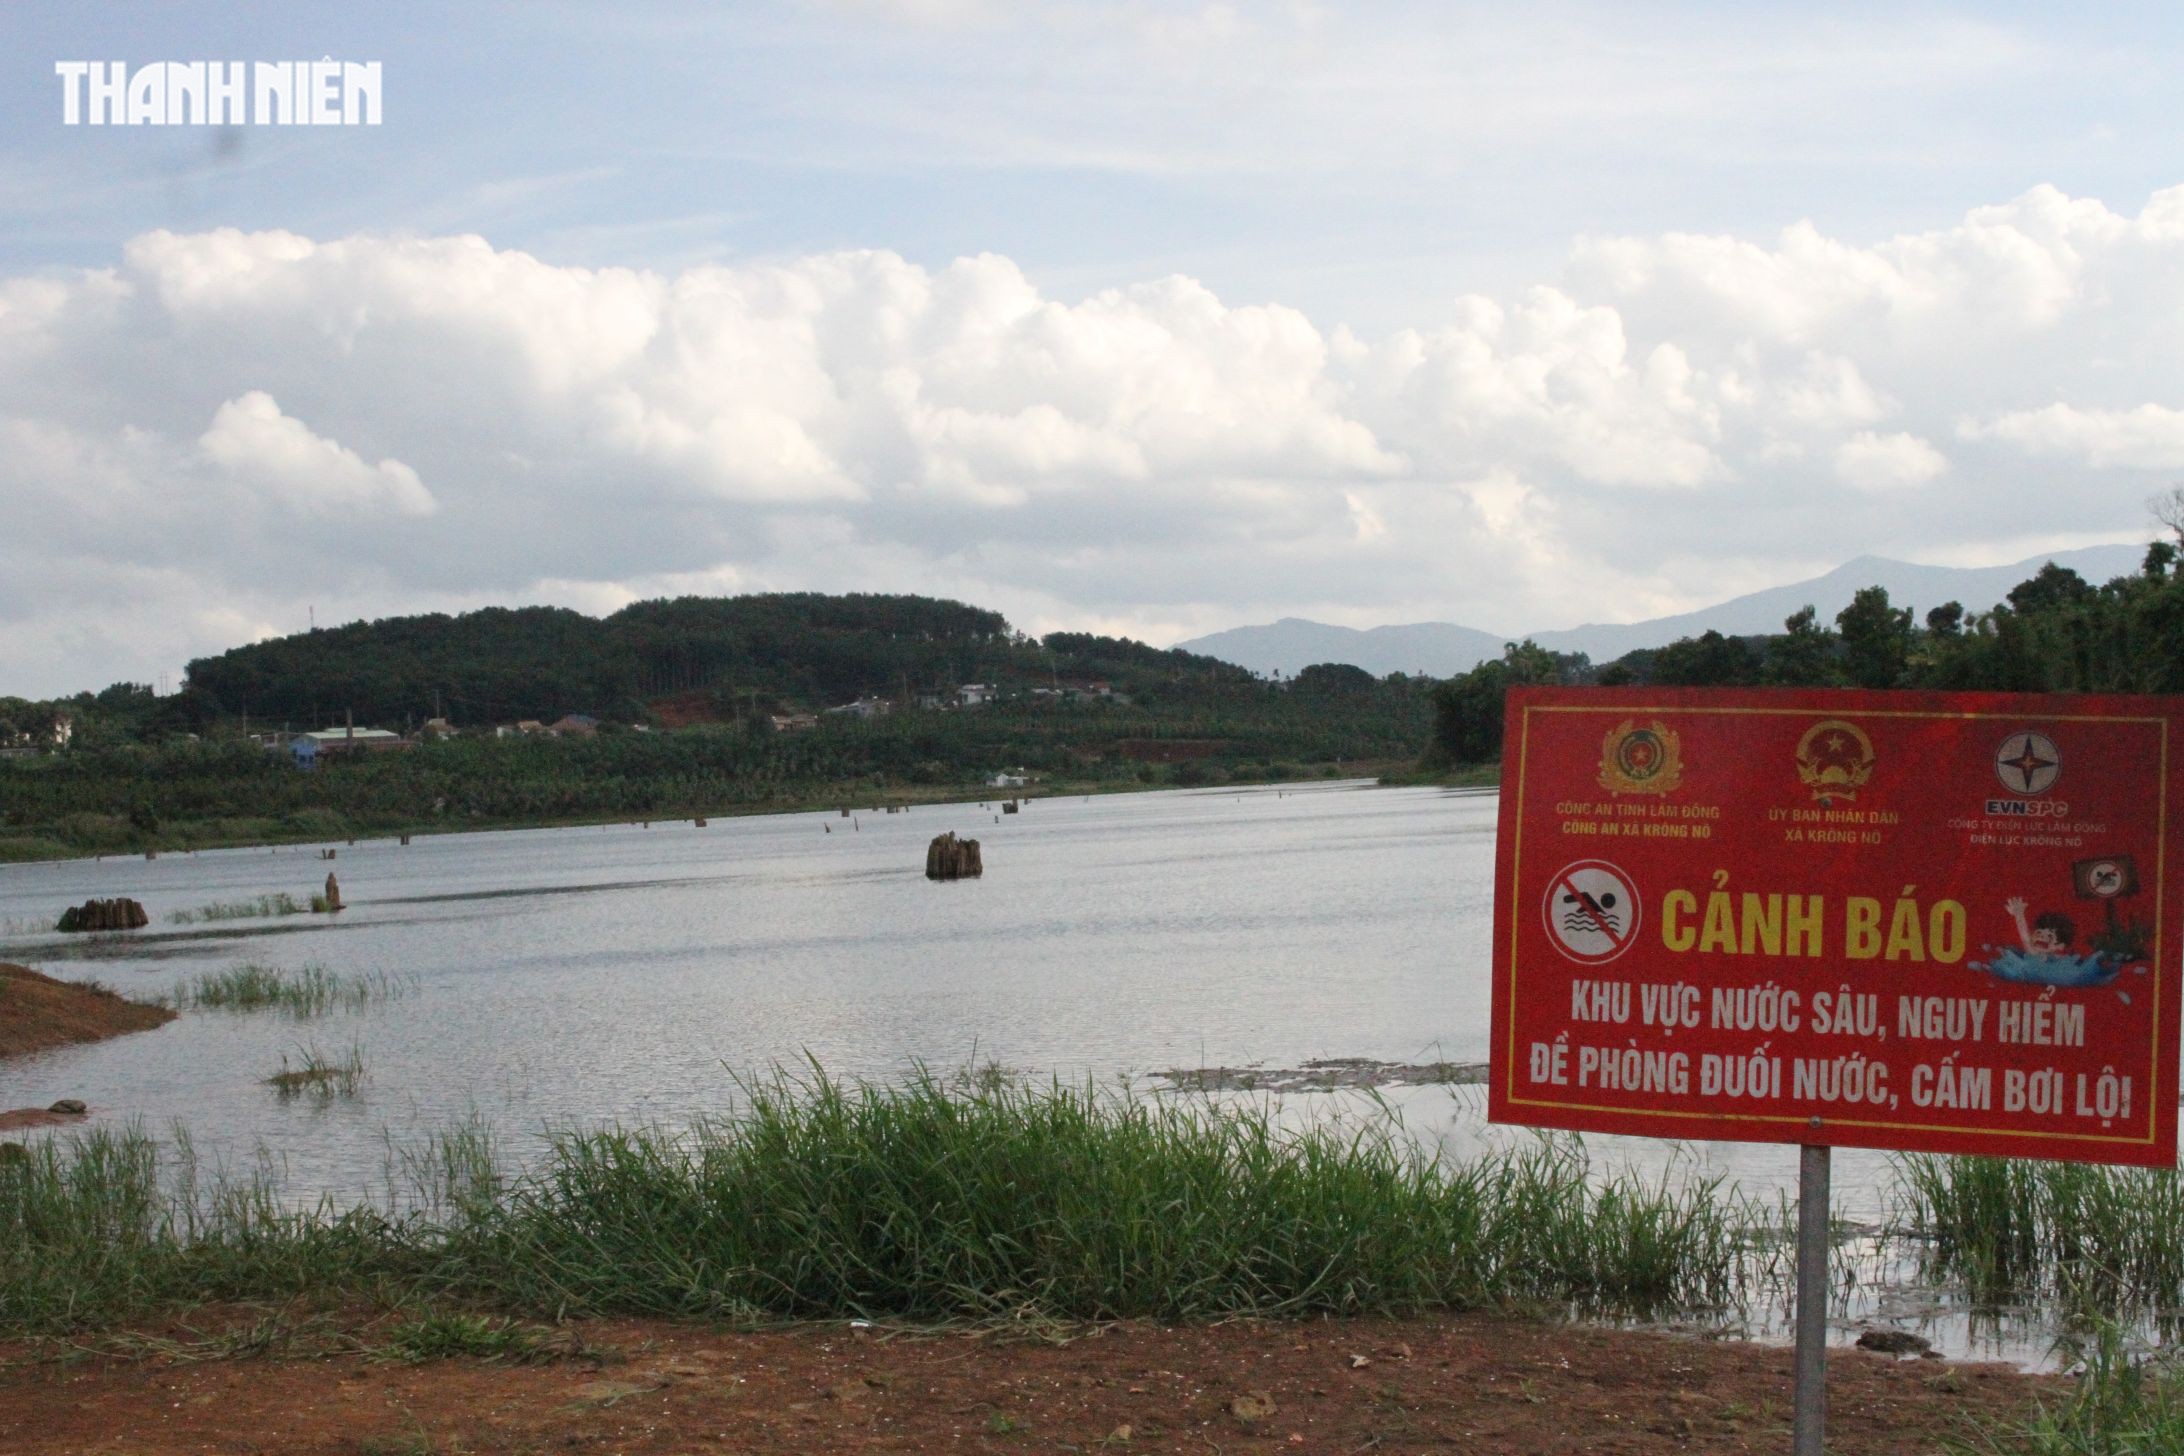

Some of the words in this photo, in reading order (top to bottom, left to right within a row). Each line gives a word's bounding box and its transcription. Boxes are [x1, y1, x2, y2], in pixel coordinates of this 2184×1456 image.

[1595, 803, 1612, 815] AN
[1601, 822, 1619, 835] AN
[1792, 808, 1820, 822] BAN
[1661, 869, 1824, 958] CẢNH
[1845, 884, 1967, 963] BÁO
[1571, 979, 1631, 1024] KHU
[1640, 980, 1701, 1036] VỰC
[1712, 980, 1801, 1033] NƯỚC
[1812, 983, 1886, 1042] SÂU,
[1898, 994, 1989, 1043] NGUY
[1998, 984, 2086, 1047] HIỂM
[1529, 1029, 1569, 1086] ĐỀ
[1578, 1038, 1690, 1096] PHÒNG
[1700, 1041, 1782, 1099] ĐUỐI
[1793, 1051, 1899, 1111] NƯỚC,
[1911, 1050, 1992, 1111] CẤM
[2004, 1067, 2064, 1115] BƠI
[2076, 1065, 2132, 1128] LỘI
